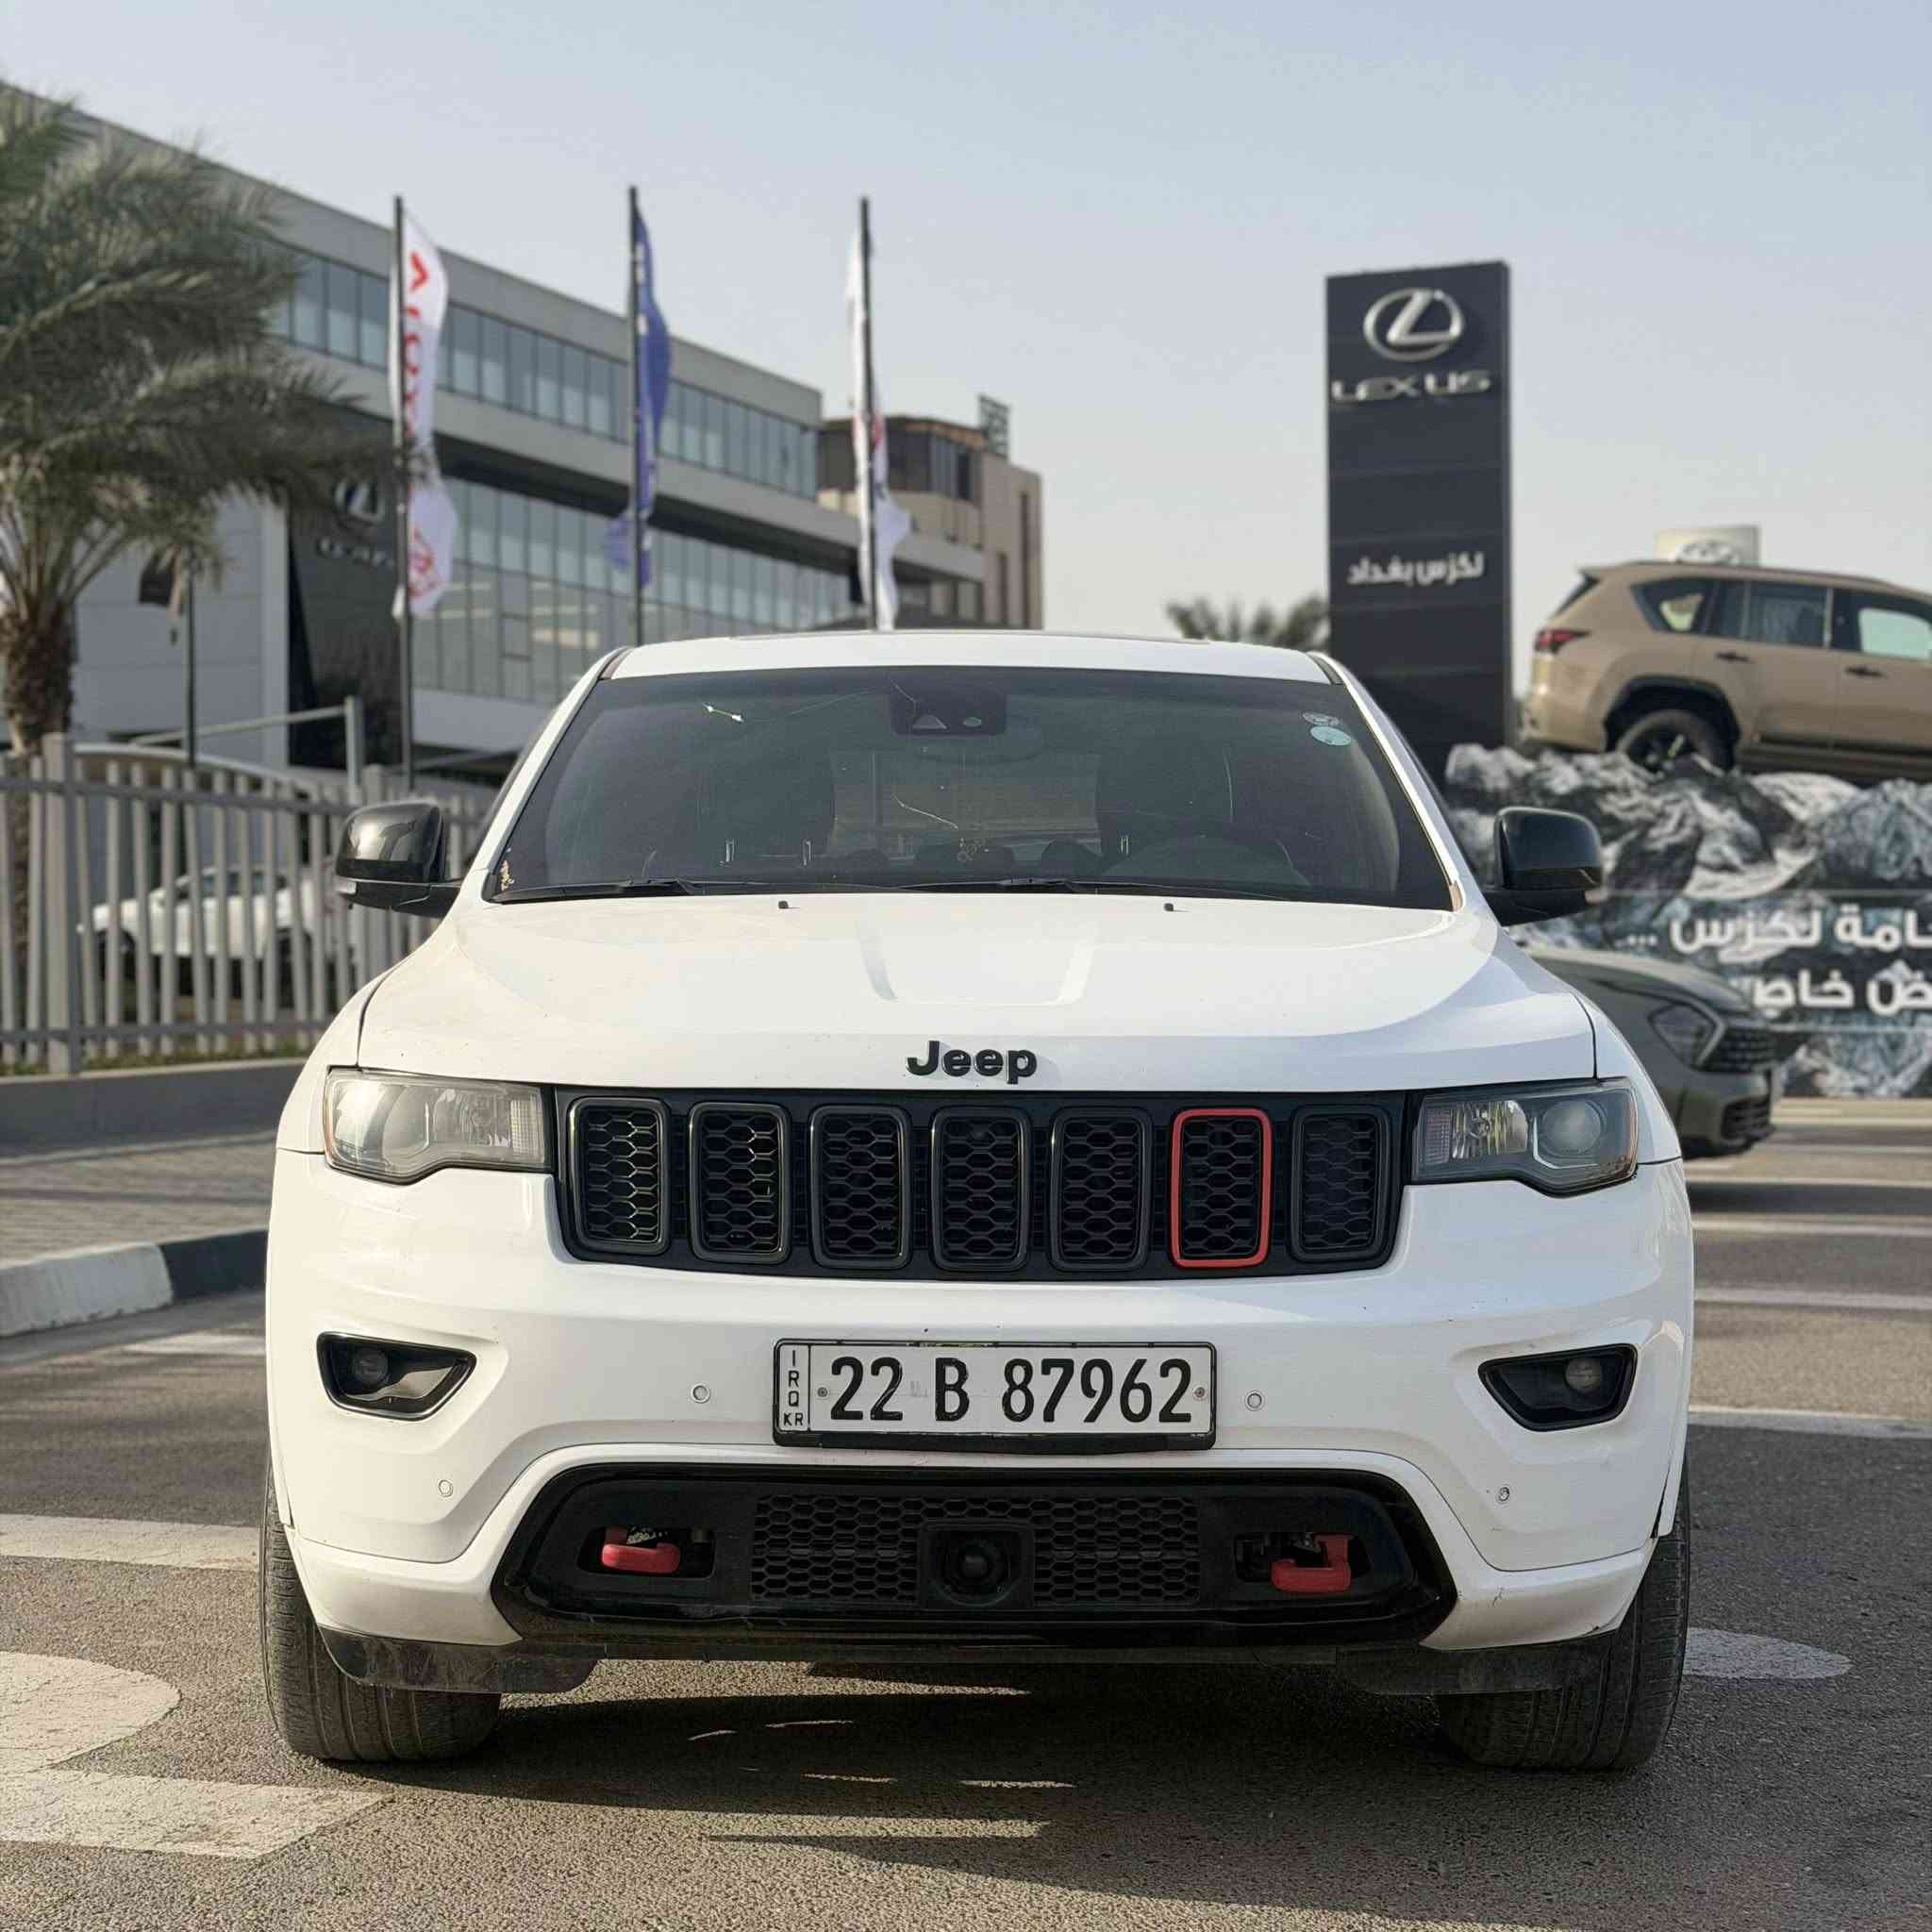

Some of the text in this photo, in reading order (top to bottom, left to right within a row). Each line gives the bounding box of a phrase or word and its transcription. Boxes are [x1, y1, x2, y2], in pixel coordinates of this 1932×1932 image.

[1331, 371, 1491, 402] LEXUS
[1669, 908, 1823, 954] لكزس
[1834, 903, 1932, 952] امة
[907, 1040, 1038, 1085] Jeep
[830, 1356, 1192, 1424] 22 B 87962
